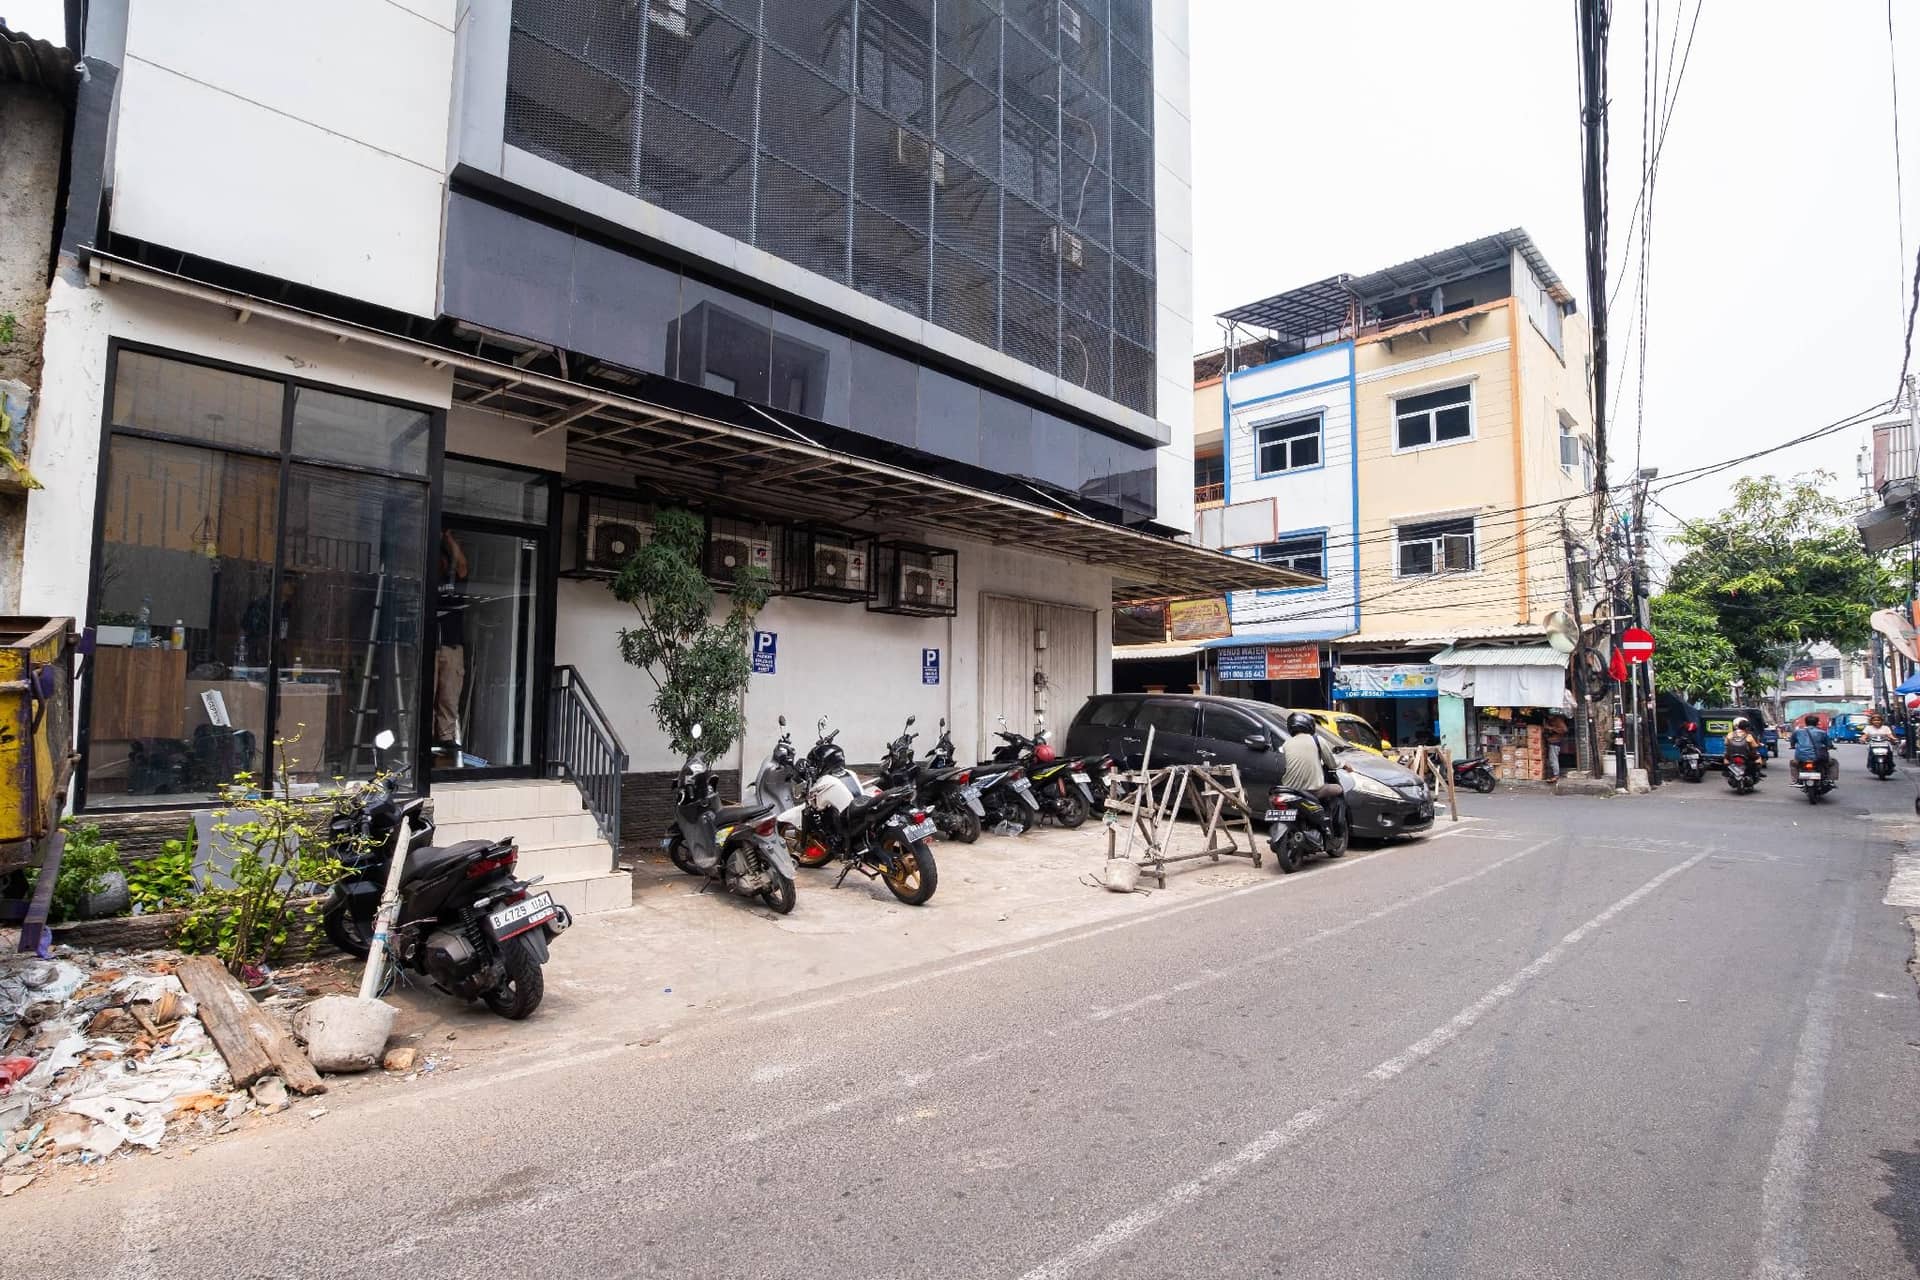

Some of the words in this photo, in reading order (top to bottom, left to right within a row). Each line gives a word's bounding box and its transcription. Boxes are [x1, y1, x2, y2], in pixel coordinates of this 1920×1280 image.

[758, 633, 772, 652] P
[1241, 646, 1265, 656] WATER
[926, 650, 937, 667] P
[493, 915, 502, 927] B
